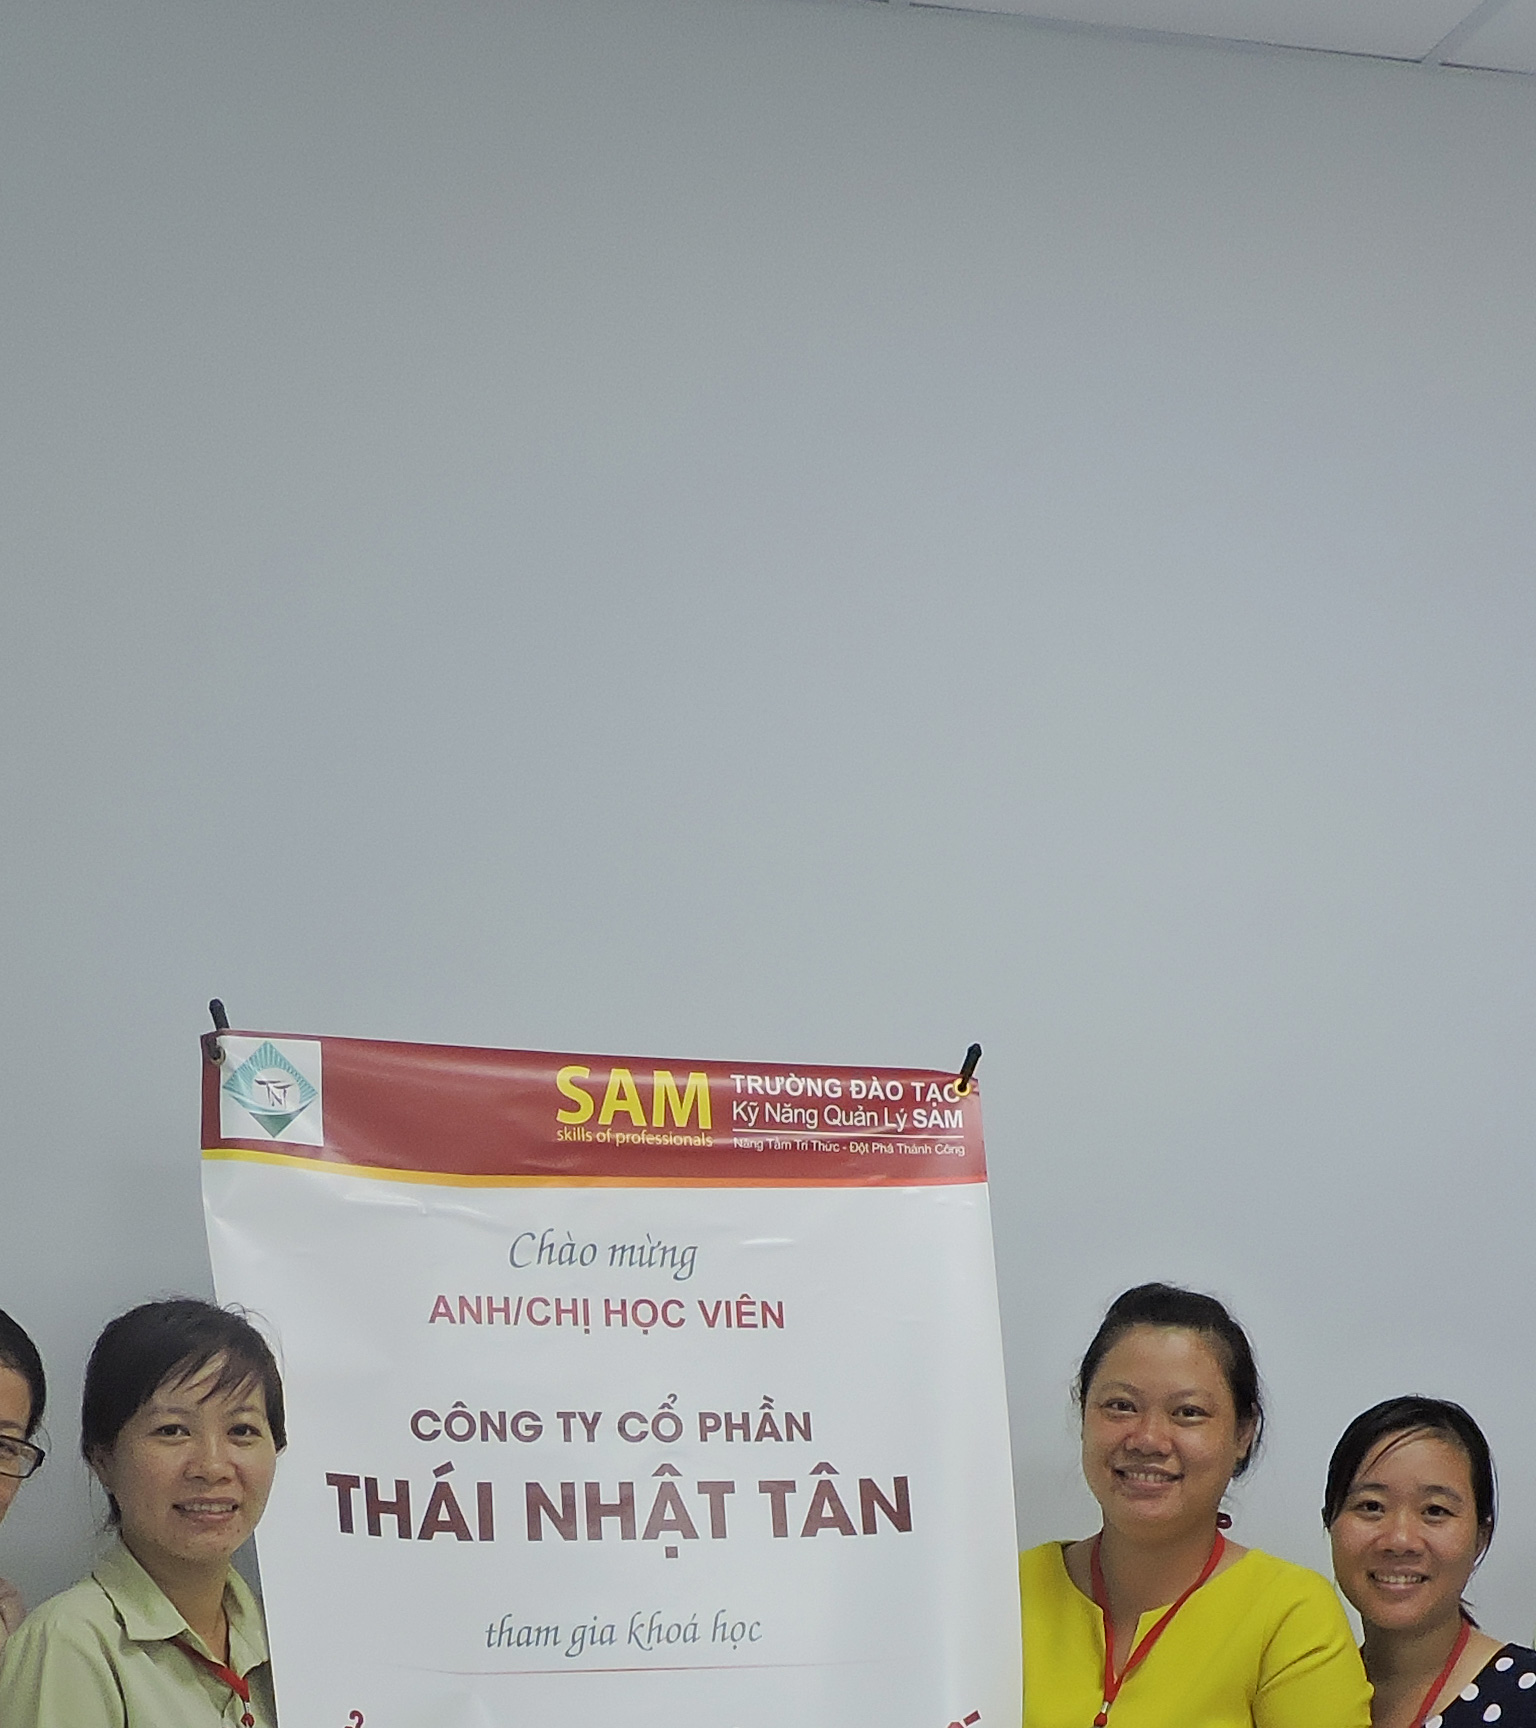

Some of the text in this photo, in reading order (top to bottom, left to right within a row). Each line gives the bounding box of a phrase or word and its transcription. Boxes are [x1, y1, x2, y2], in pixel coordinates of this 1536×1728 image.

[556, 1065, 712, 1130] SAM
[730, 1072, 843, 1098] TRƯỜNG
[850, 1075, 904, 1101] ĐÀO
[556, 1126, 714, 1148] skills of professionals
[732, 1100, 963, 1132] Kỹ Năng Quản Lý SAM
[508, 1227, 699, 1281] Chào mừng
[429, 1293, 785, 1336] ANH/CHỊ HỌC VIÊN
[410, 1394, 813, 1443] CÔNG TY CỔ PHẦN
[326, 1460, 912, 1559] THÁI NHẬT TÂN
[485, 1609, 763, 1658] tham gia khoá học
